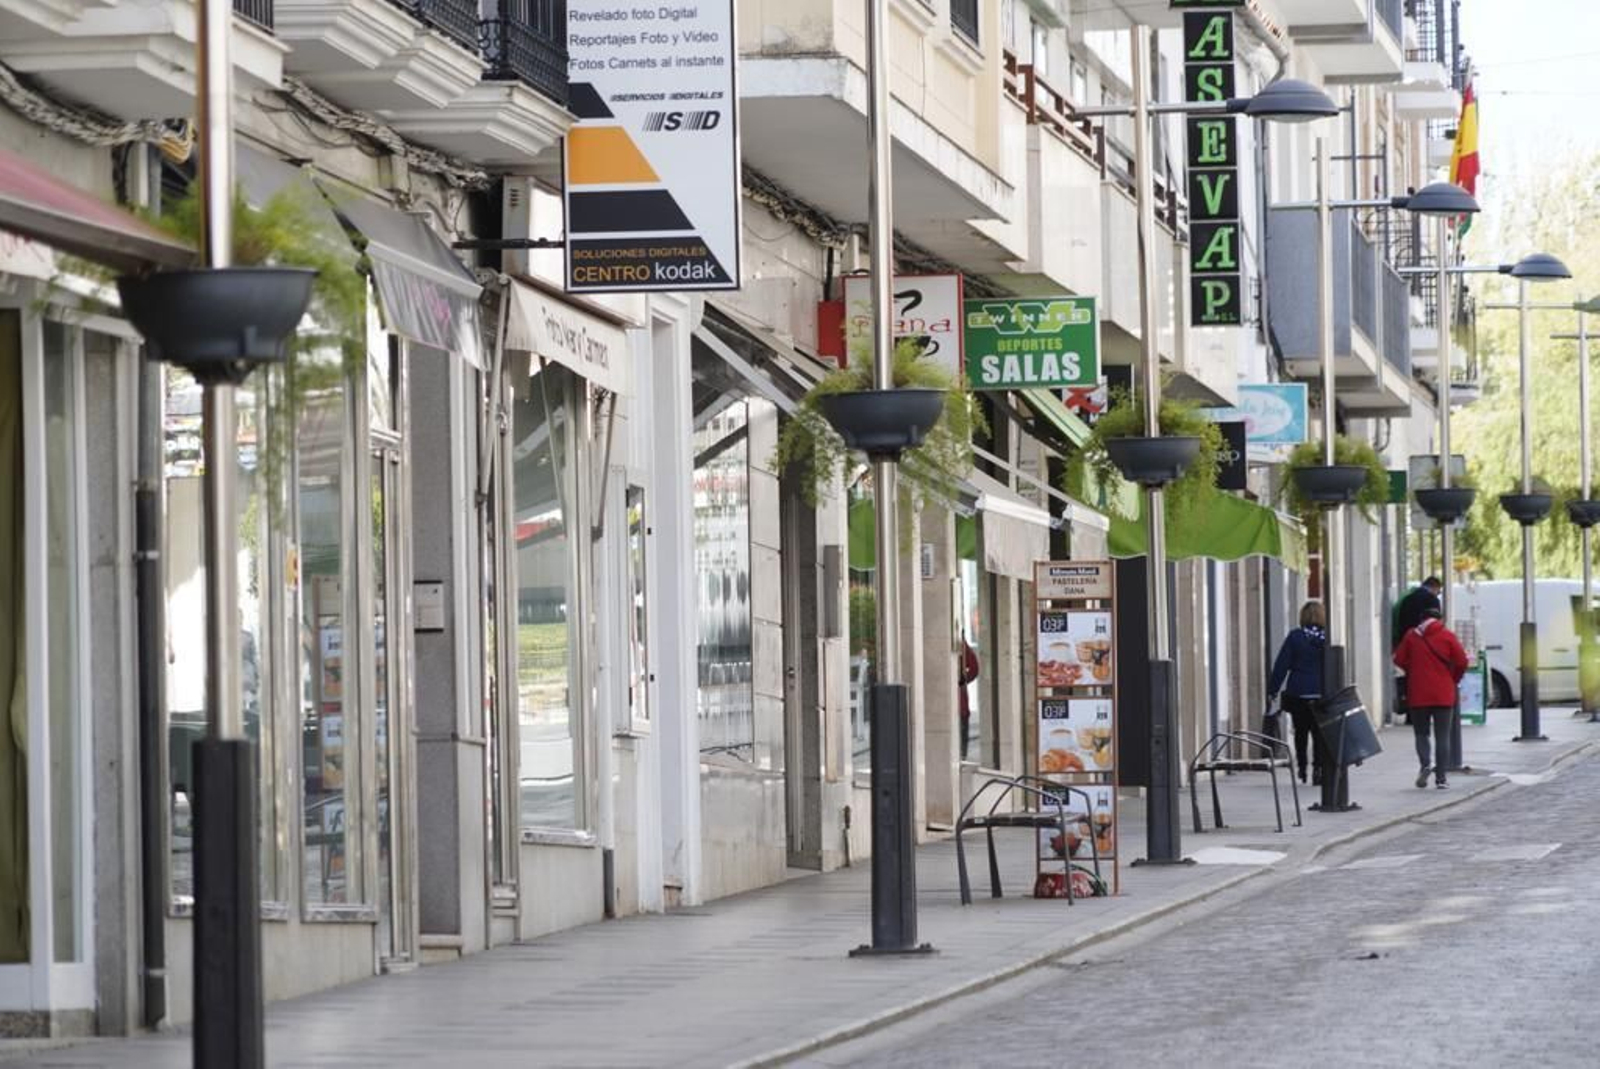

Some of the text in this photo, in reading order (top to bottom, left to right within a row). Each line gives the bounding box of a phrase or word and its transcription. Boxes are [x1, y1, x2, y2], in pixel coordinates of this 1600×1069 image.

[569, 6, 697, 22] Revelado foto Digital
[569, 34, 637, 47] Reportajes
[640, 32, 668, 44] Foto
[672, 35, 679, 45] y
[569, 55, 724, 70] Fotos Carnets al instante
[617, 91, 724, 101] SERVICIOS DIGITALES
[573, 246, 708, 259] SOLUCIONES DIGITALES
[573, 260, 716, 282] CENTRO kodak
[997, 337, 1063, 352] DEPORTES
[981, 351, 1081, 384] SALAS
